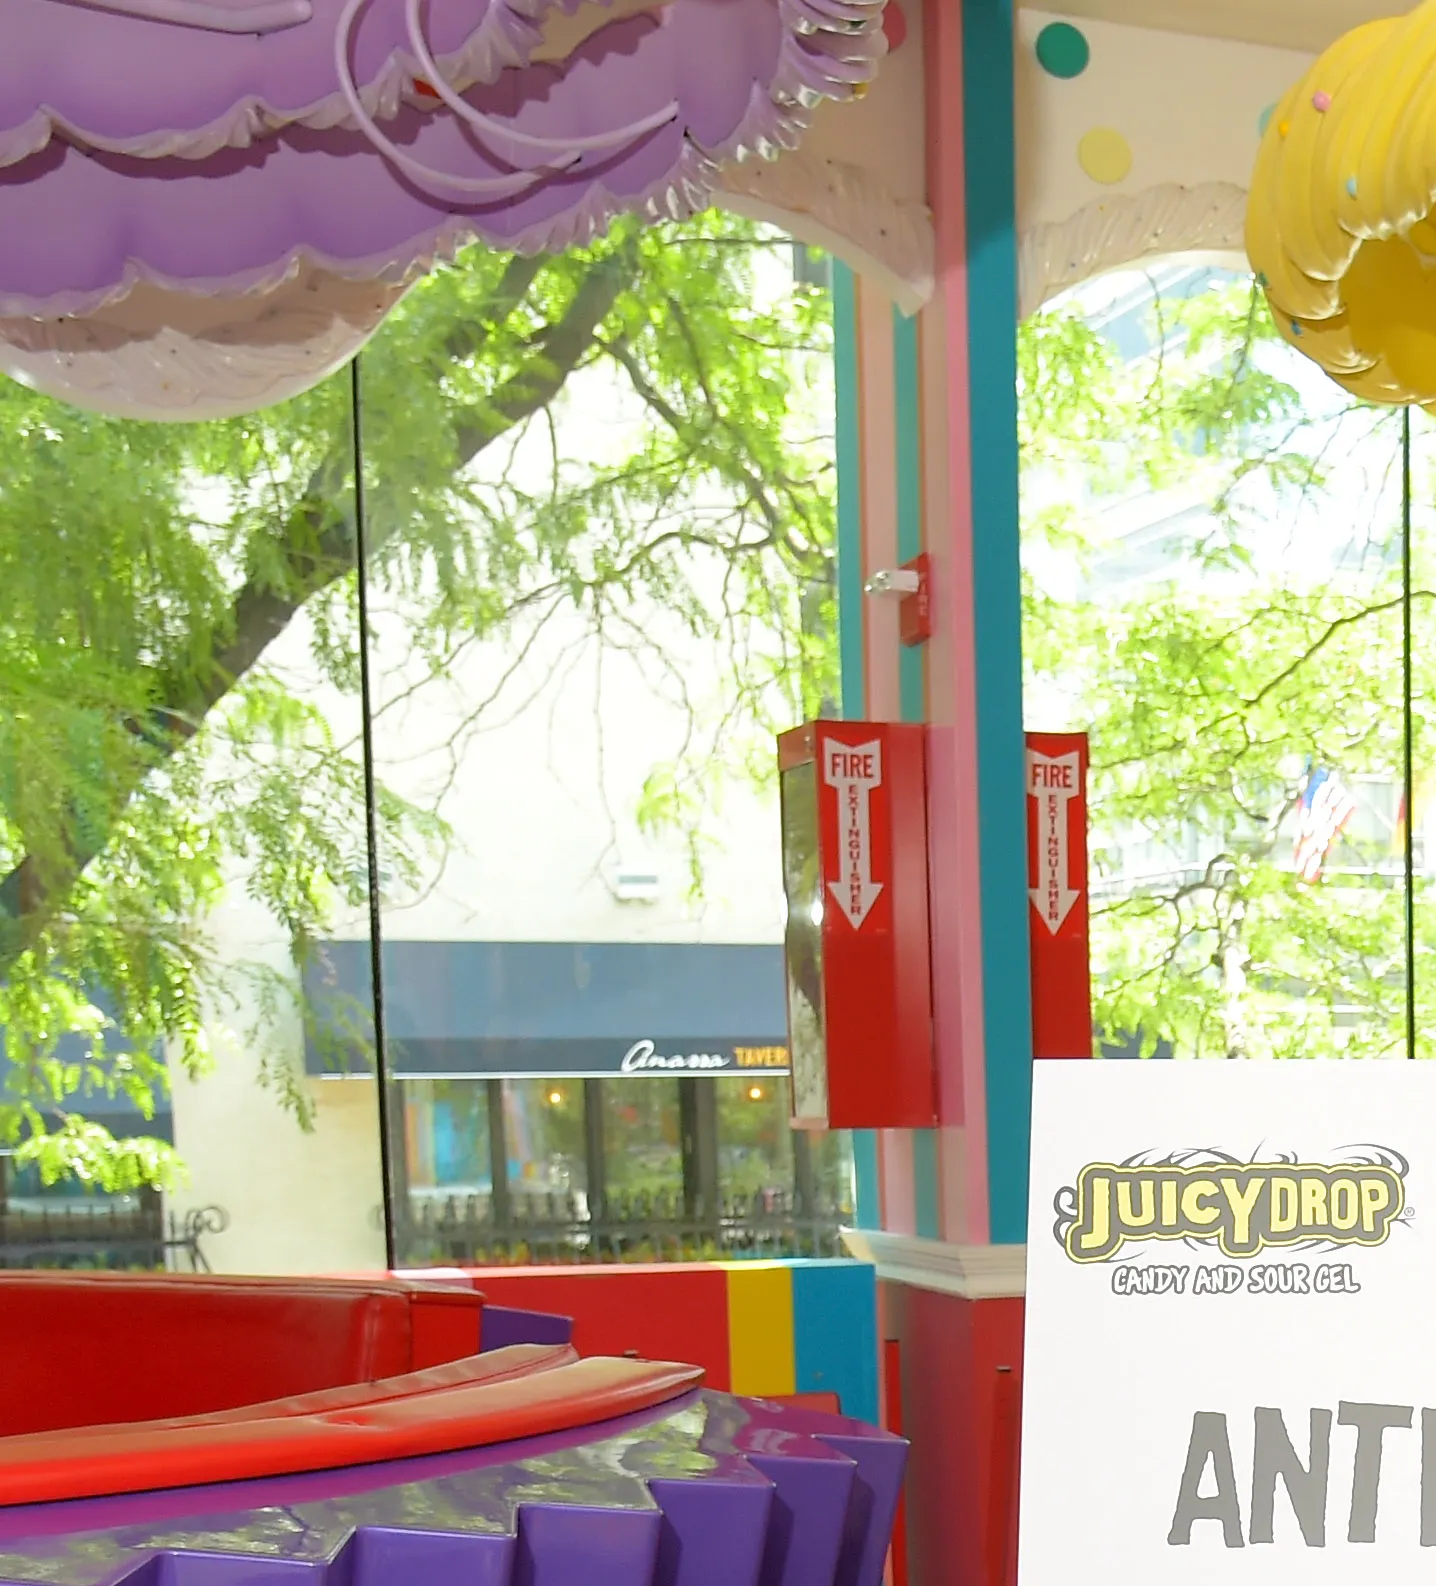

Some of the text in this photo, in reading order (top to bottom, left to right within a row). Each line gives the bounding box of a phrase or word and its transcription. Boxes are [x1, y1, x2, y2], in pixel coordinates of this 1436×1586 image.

[831, 753, 875, 778] FIRE
[1032, 763, 1074, 789] FIRE
[848, 784, 862, 915] EXTINGUISHER
[1047, 794, 1060, 921] EXTINGUISHER
[1111, 1263, 1361, 1296] CANDY AND SOUR GEL
